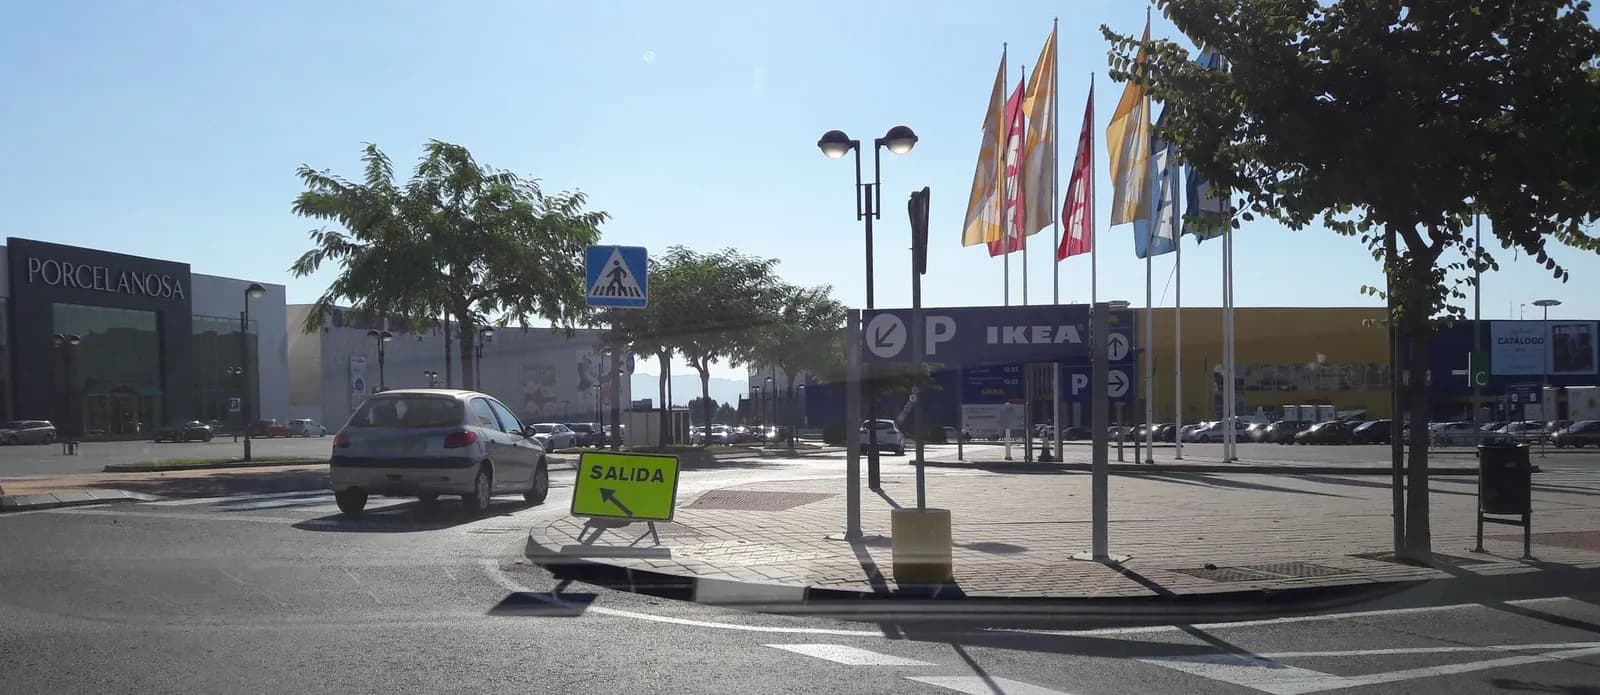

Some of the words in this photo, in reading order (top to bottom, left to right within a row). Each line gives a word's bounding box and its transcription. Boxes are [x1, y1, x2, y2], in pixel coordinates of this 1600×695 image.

[28, 257, 185, 300] PORCELANOSA
[926, 315, 957, 355] P
[986, 325, 1083, 345] IKEA
[1071, 373, 1089, 395] P
[1475, 371, 1487, 386] C
[590, 465, 665, 483] SALIDA
